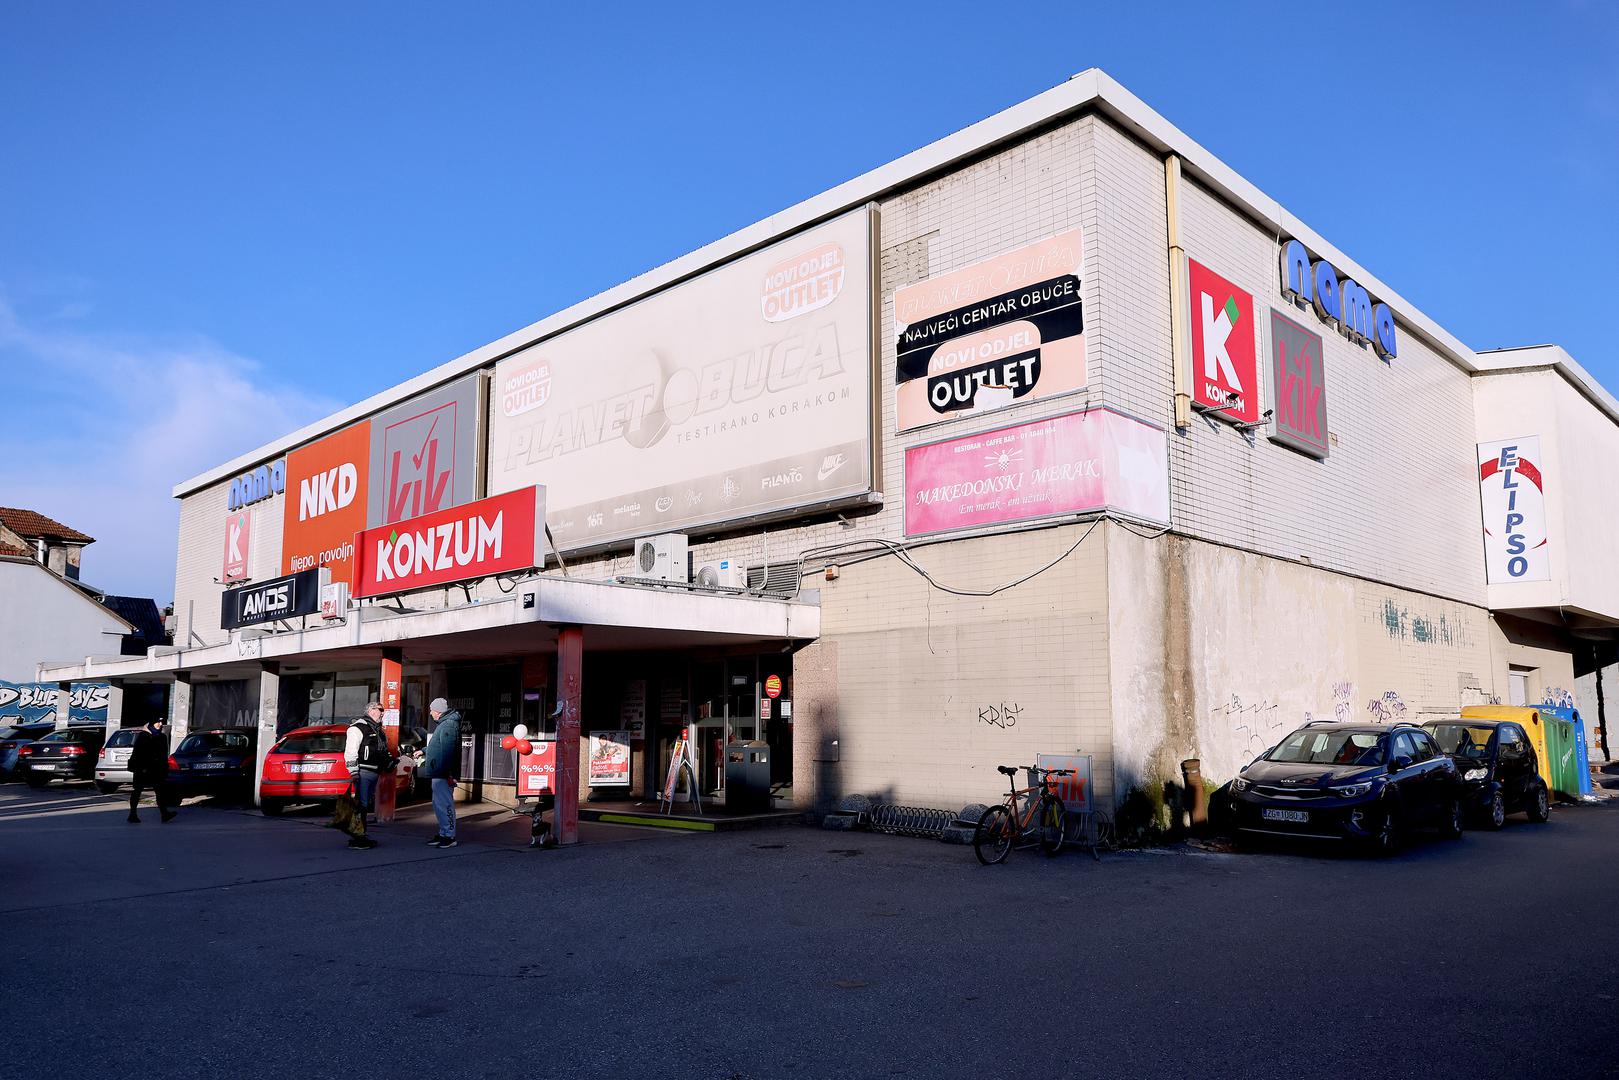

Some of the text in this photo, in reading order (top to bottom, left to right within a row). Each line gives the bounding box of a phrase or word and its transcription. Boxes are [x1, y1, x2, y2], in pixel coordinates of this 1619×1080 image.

[764, 271, 842, 318] OUTLET
[905, 280, 1074, 343] NAJVEĆI CENTAR OBUĆE
[1279, 239, 1397, 360] nama
[933, 330, 1033, 371] NOVI ODJEL
[1201, 291, 1244, 393] K
[504, 380, 550, 414] OUTLET
[931, 357, 1036, 408] OUTLET
[677, 387, 850, 444] TESTIRANO KORAKOM
[227, 459, 285, 511] nama
[299, 462, 358, 522] NKD
[915, 458, 1101, 506] MAKEDONSKI MERAK
[1499, 445, 1529, 577] ELIPSO
[319, 541, 354, 568] povoljn
[375, 509, 503, 583] KONZUM
